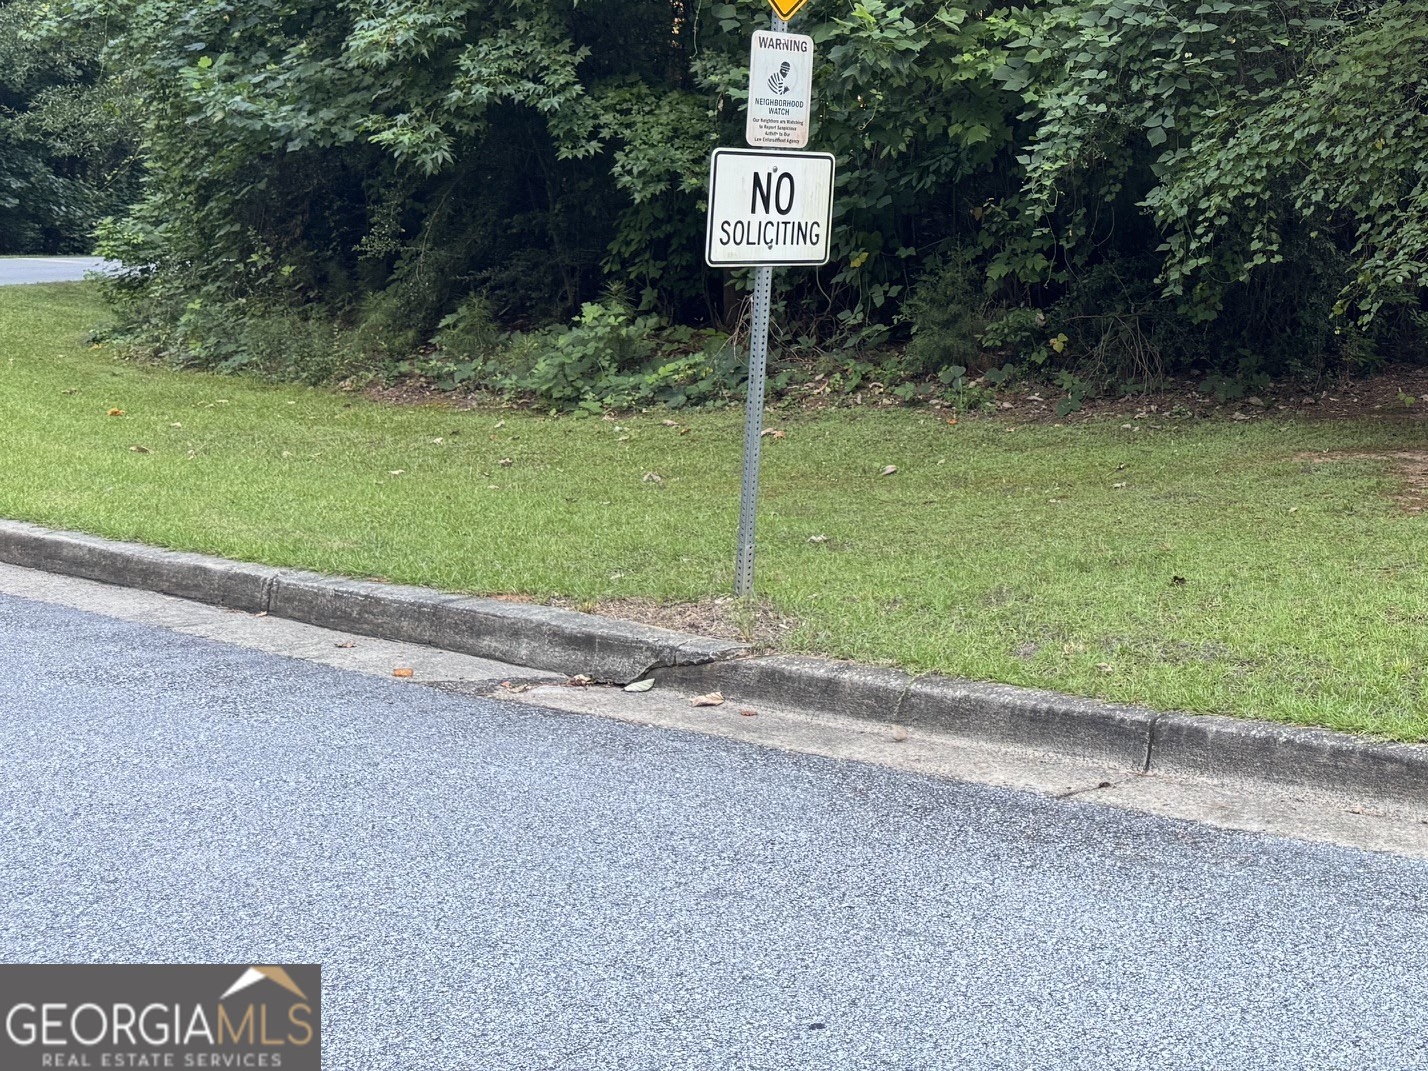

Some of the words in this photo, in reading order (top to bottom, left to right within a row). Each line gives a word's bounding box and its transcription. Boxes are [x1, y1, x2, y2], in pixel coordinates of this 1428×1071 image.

[758, 36, 808, 53] WARNING
[755, 98, 804, 108] NEIGHBORHOOD
[768, 107, 790, 116] WATCH
[751, 171, 795, 215] NO
[719, 220, 821, 246] SOLICITING
